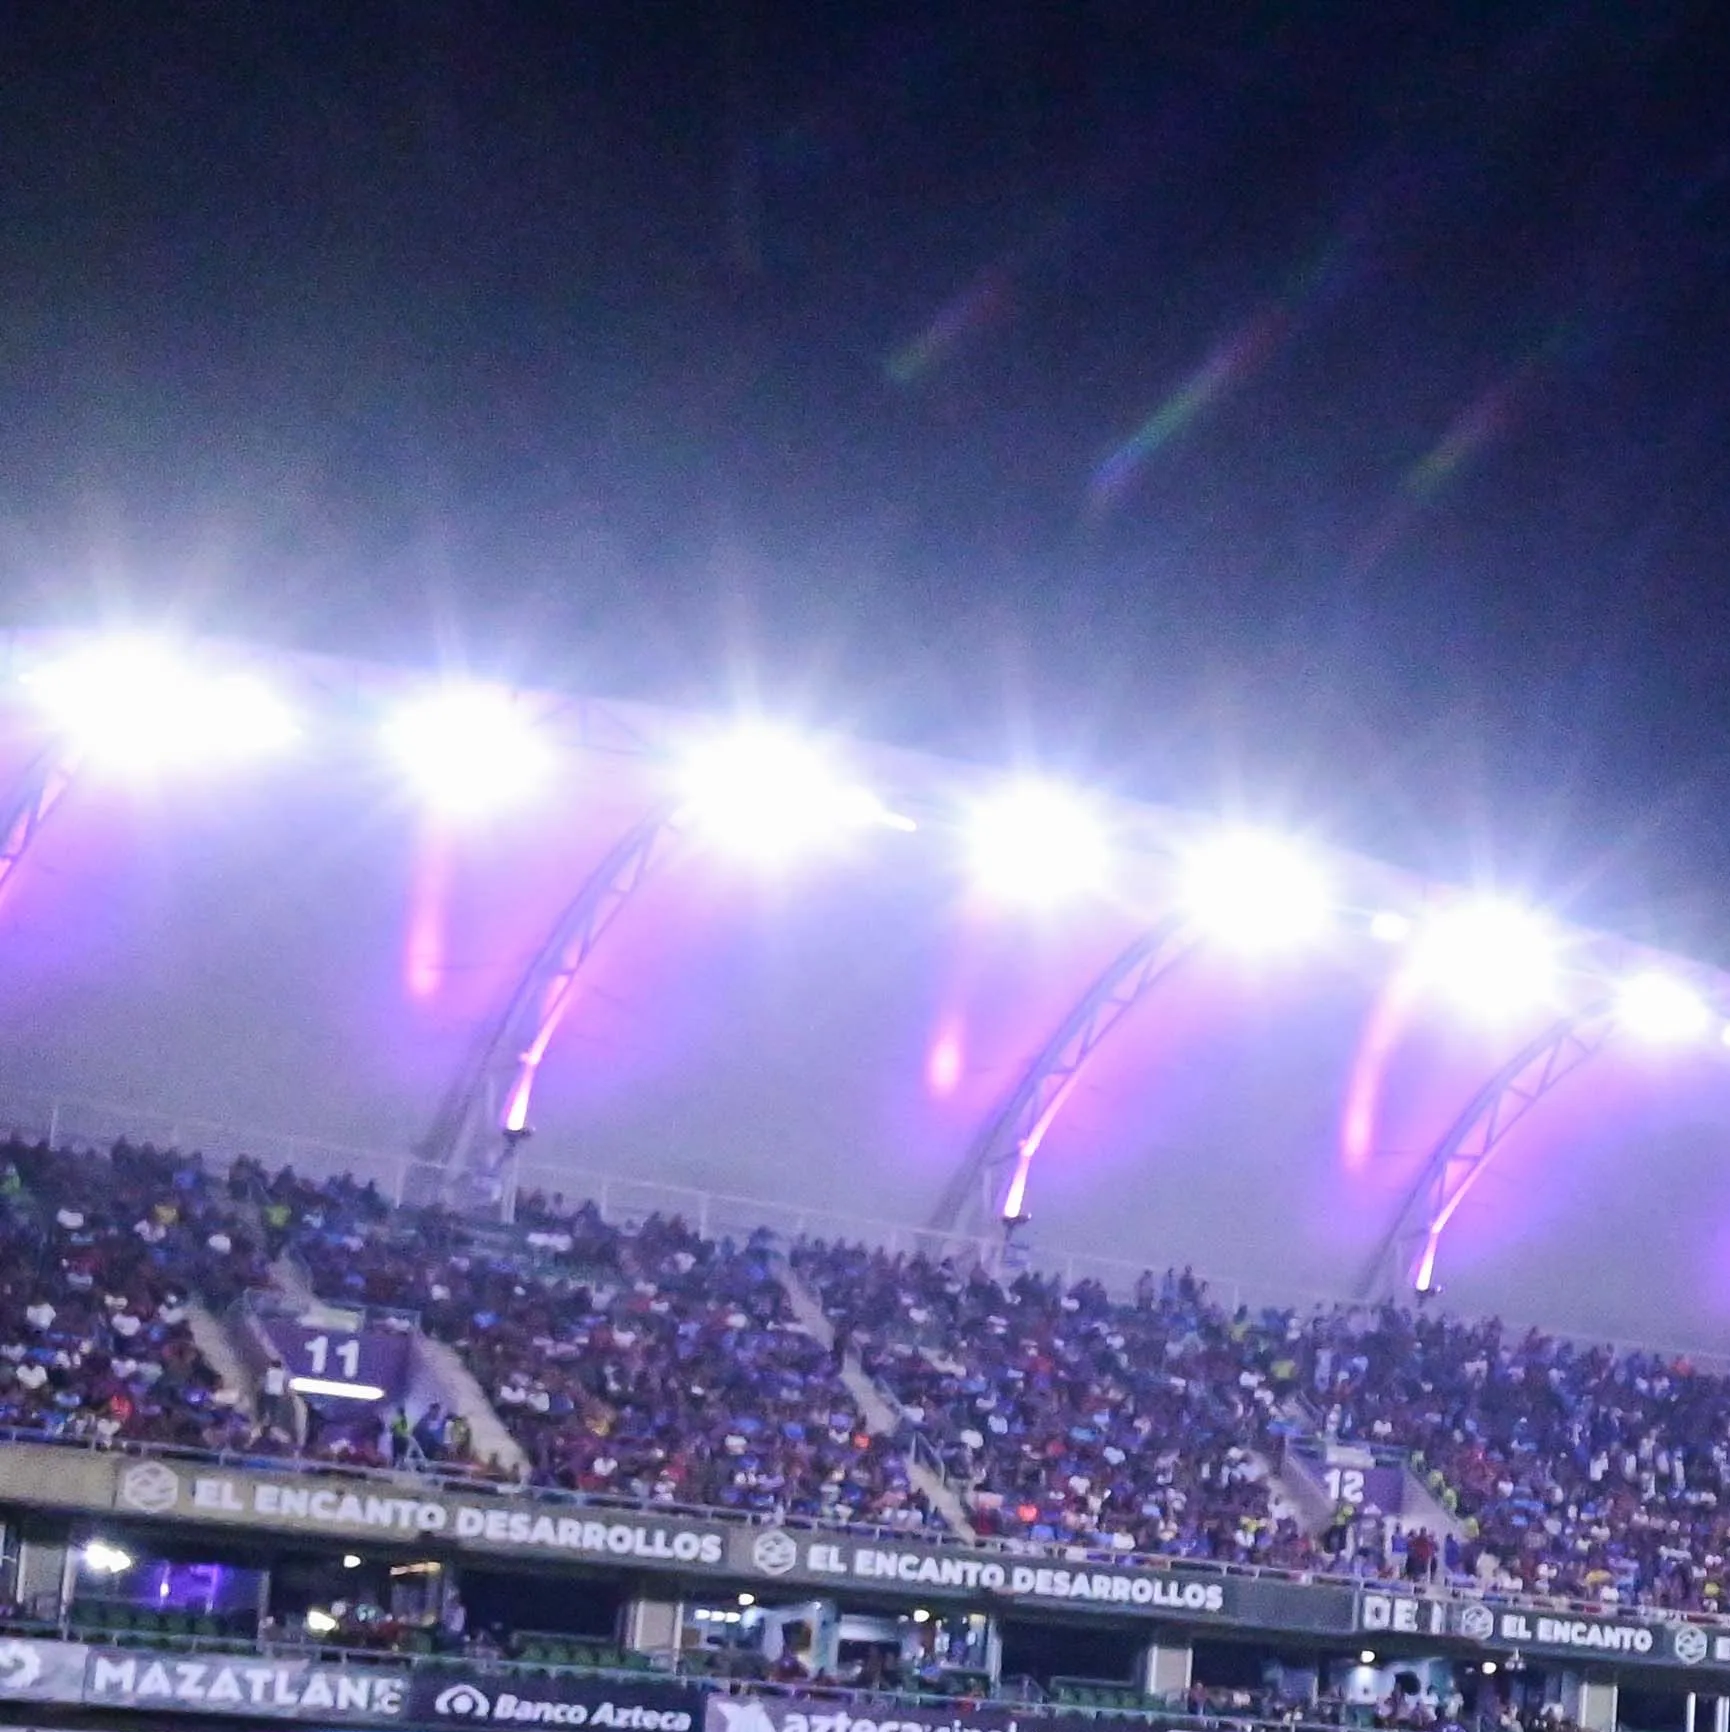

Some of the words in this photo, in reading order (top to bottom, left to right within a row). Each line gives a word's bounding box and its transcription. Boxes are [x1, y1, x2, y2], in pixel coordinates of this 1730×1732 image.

[304, 1336, 361, 1377] 11
[1324, 1468, 1364, 1503] 12
[194, 1479, 243, 1510] EL
[254, 1484, 447, 1530] ENCANTO
[456, 1507, 722, 1563] DESARROLLOS
[807, 1545, 847, 1573] EL
[855, 1549, 999, 1588] ENCANTO
[1012, 1566, 1223, 1610] DESARROLLOS
[1364, 1597, 1418, 1633] DE
[1501, 1615, 1531, 1639] EL
[1538, 1617, 1653, 1652] ENCANTO
[494, 1694, 588, 1724] Banco
[590, 1702, 692, 1732] Azteca
